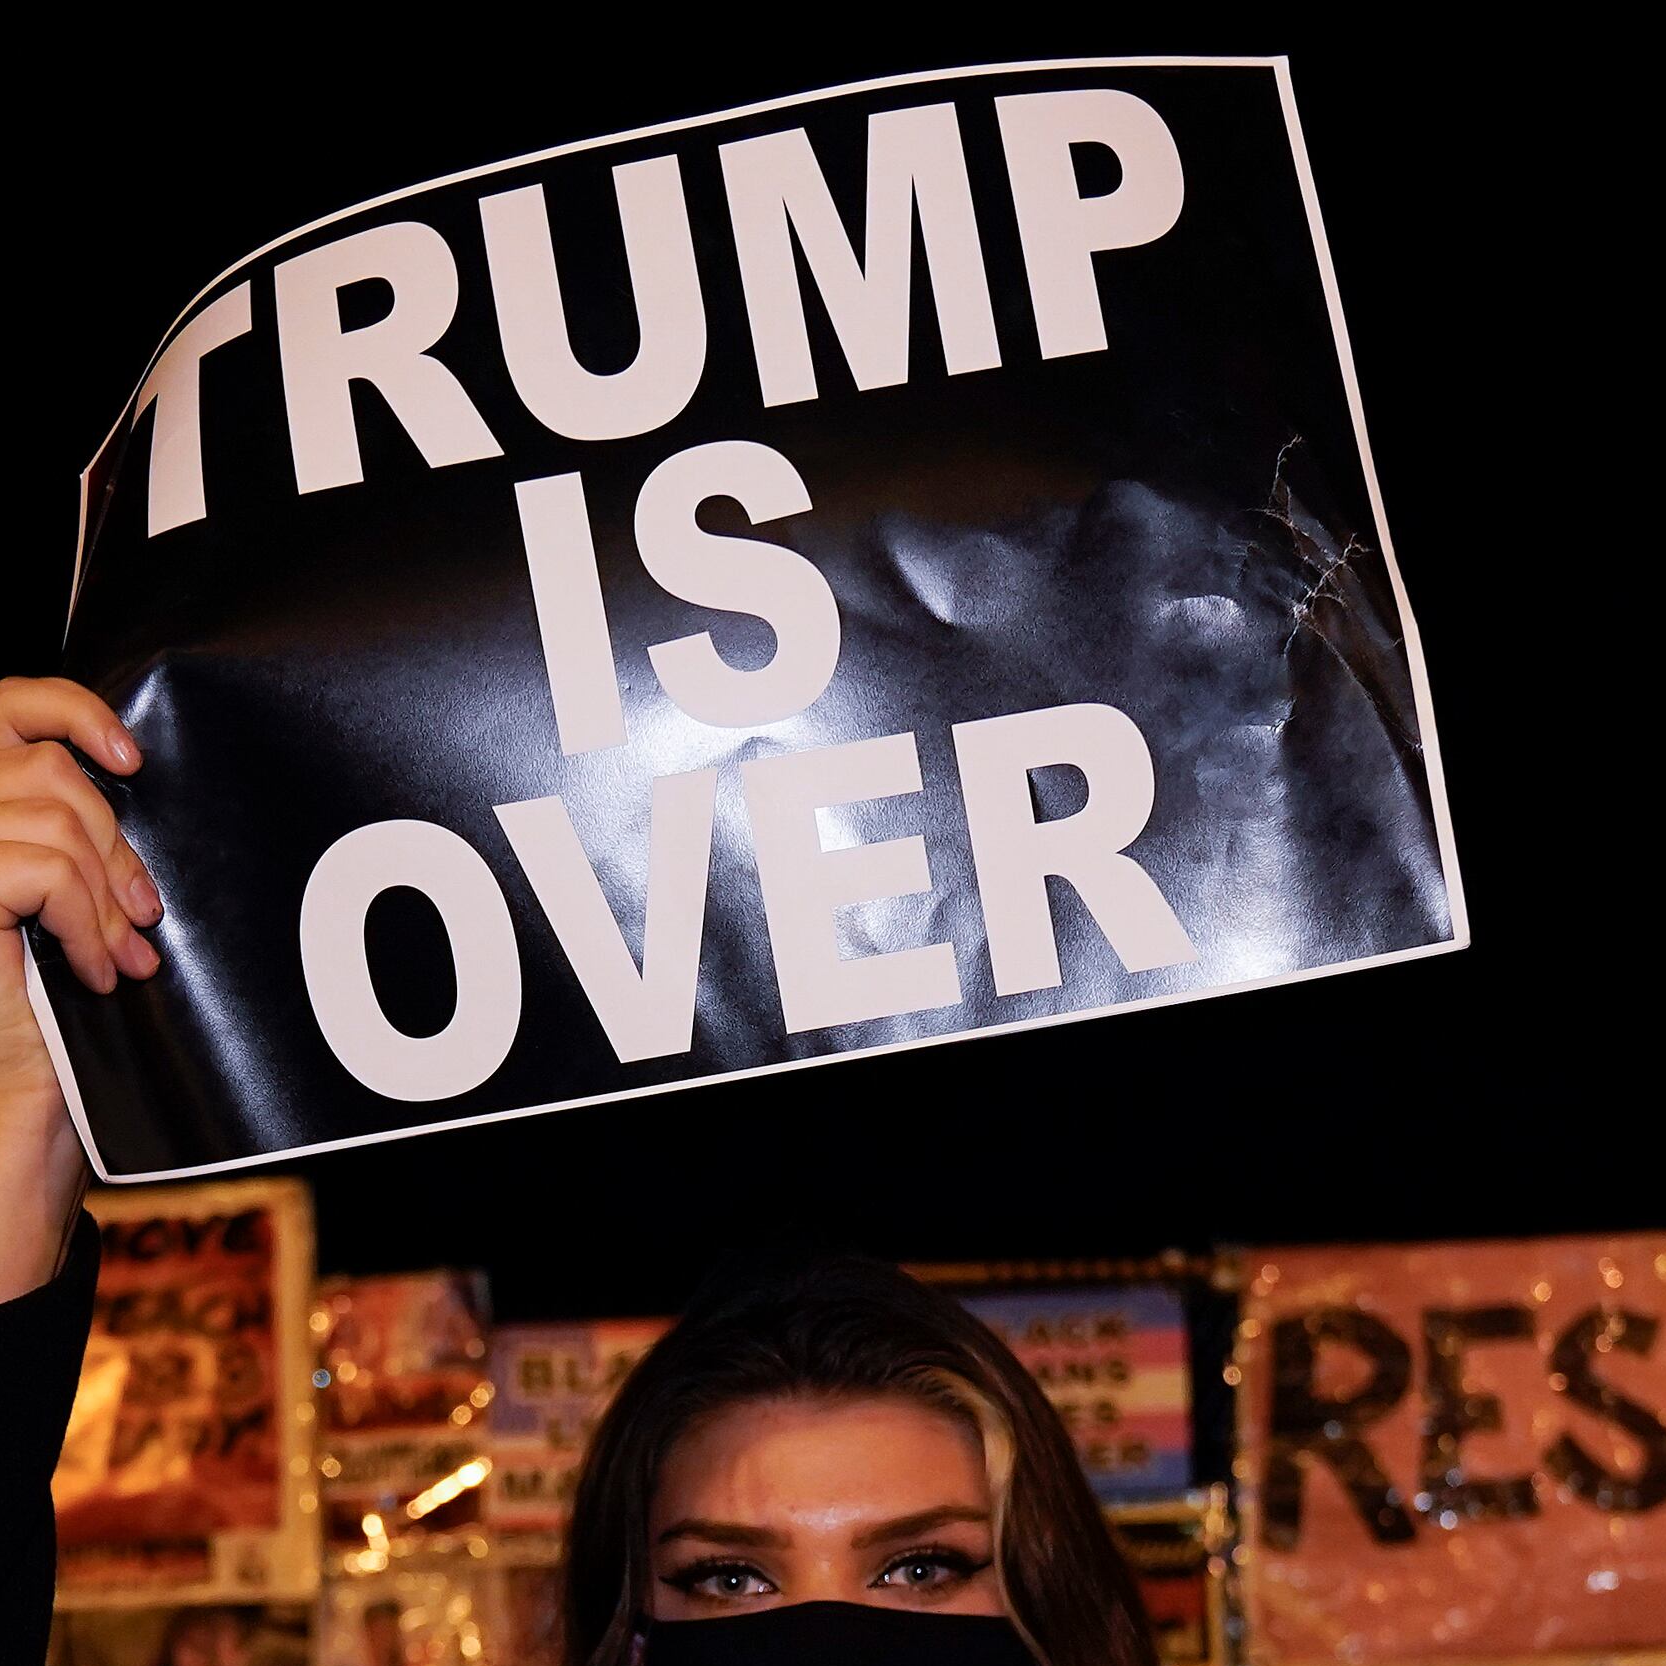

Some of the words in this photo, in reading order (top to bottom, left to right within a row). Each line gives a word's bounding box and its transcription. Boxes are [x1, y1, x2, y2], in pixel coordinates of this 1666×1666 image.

[130, 86, 1186, 541] TRUMP
[513, 438, 843, 758] IS
[298, 699, 1194, 1104] OVER
